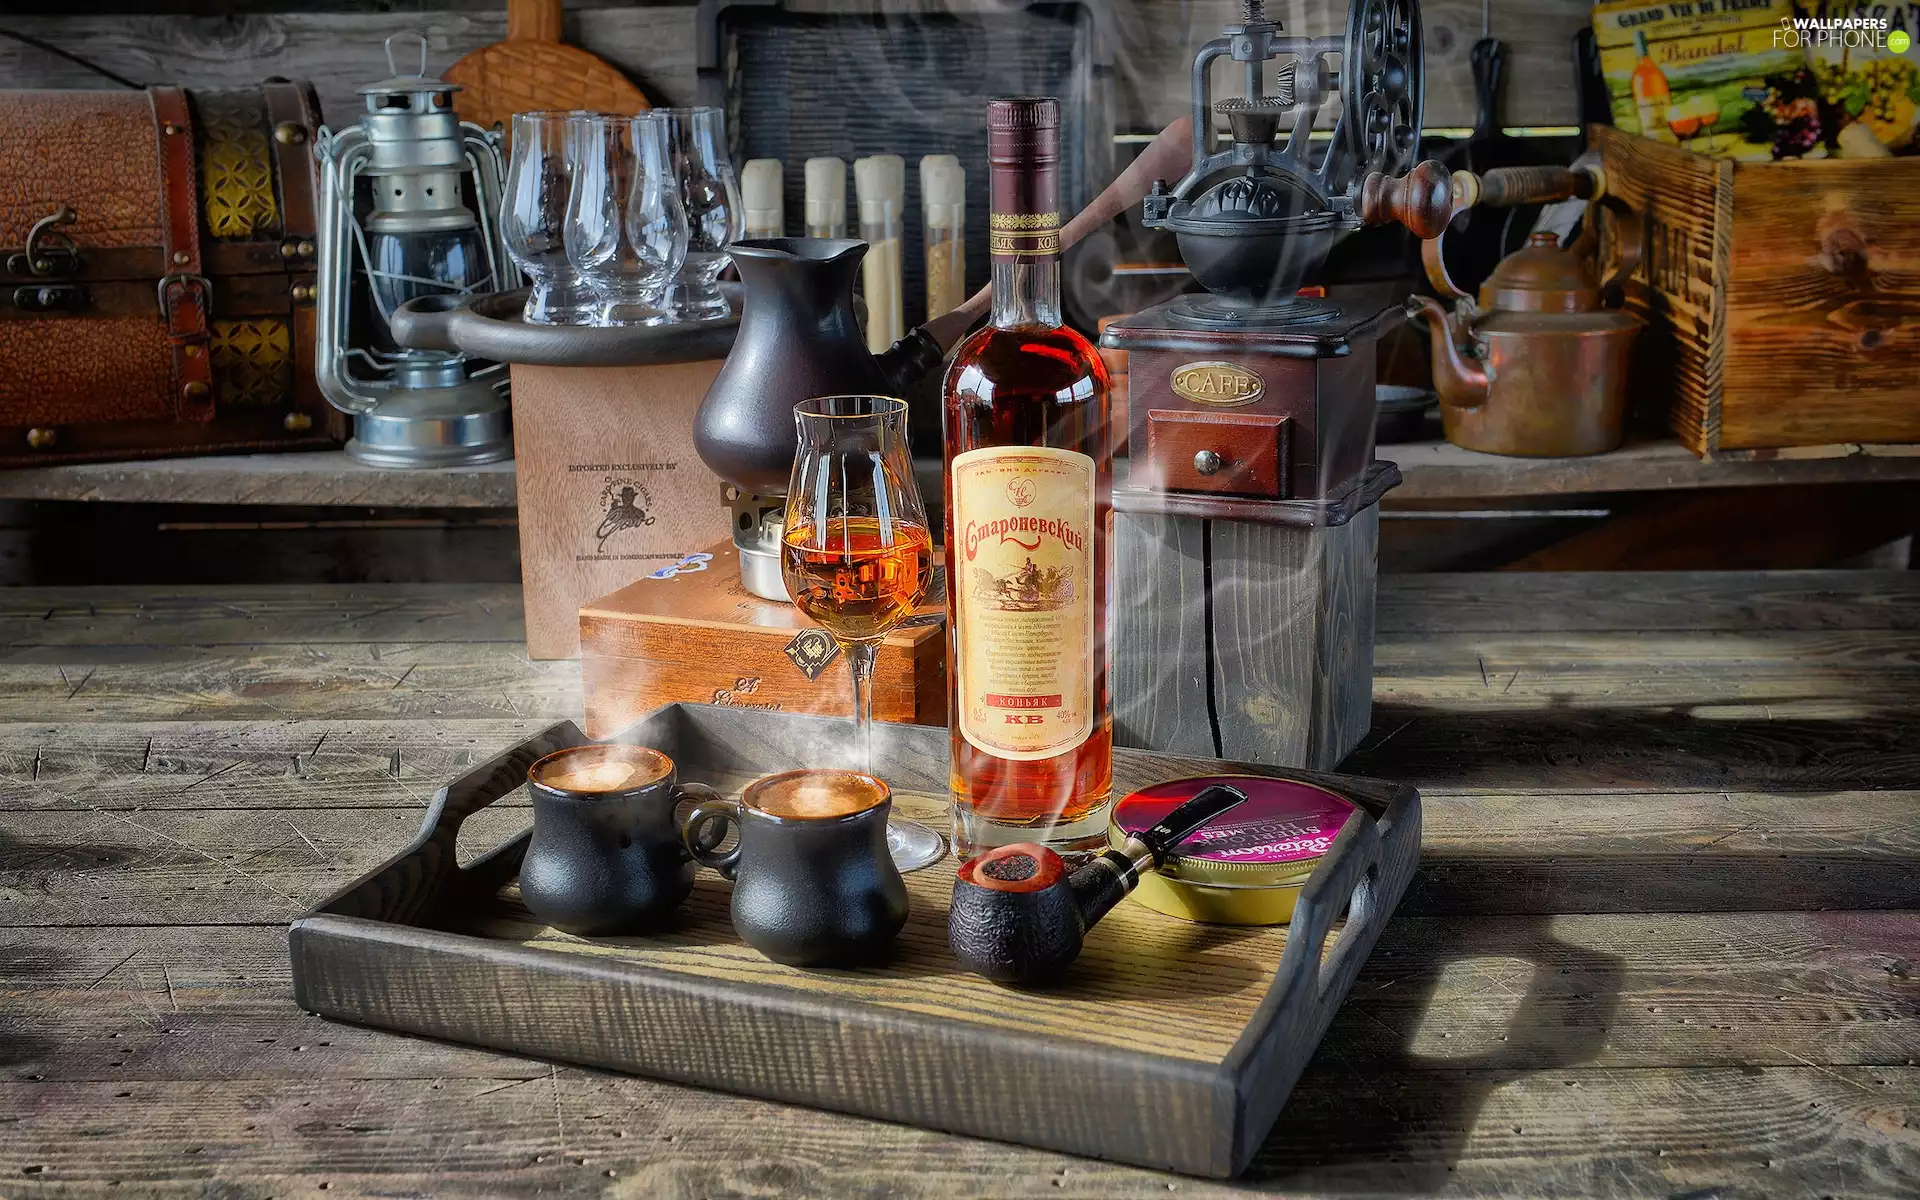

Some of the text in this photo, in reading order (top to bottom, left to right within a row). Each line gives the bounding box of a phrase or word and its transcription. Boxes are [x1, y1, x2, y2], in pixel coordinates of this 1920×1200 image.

[1184, 372, 1250, 395] CAFE
[611, 463, 665, 471] EXCLUSIVELY
[965, 516, 1083, 561] Староневский
[1000, 698, 1049, 706] КОНЬЯК
[1192, 825, 1321, 847] SHERLOCK
[1200, 821, 1298, 840] HOLMES
[1215, 837, 1332, 858] Peterson
